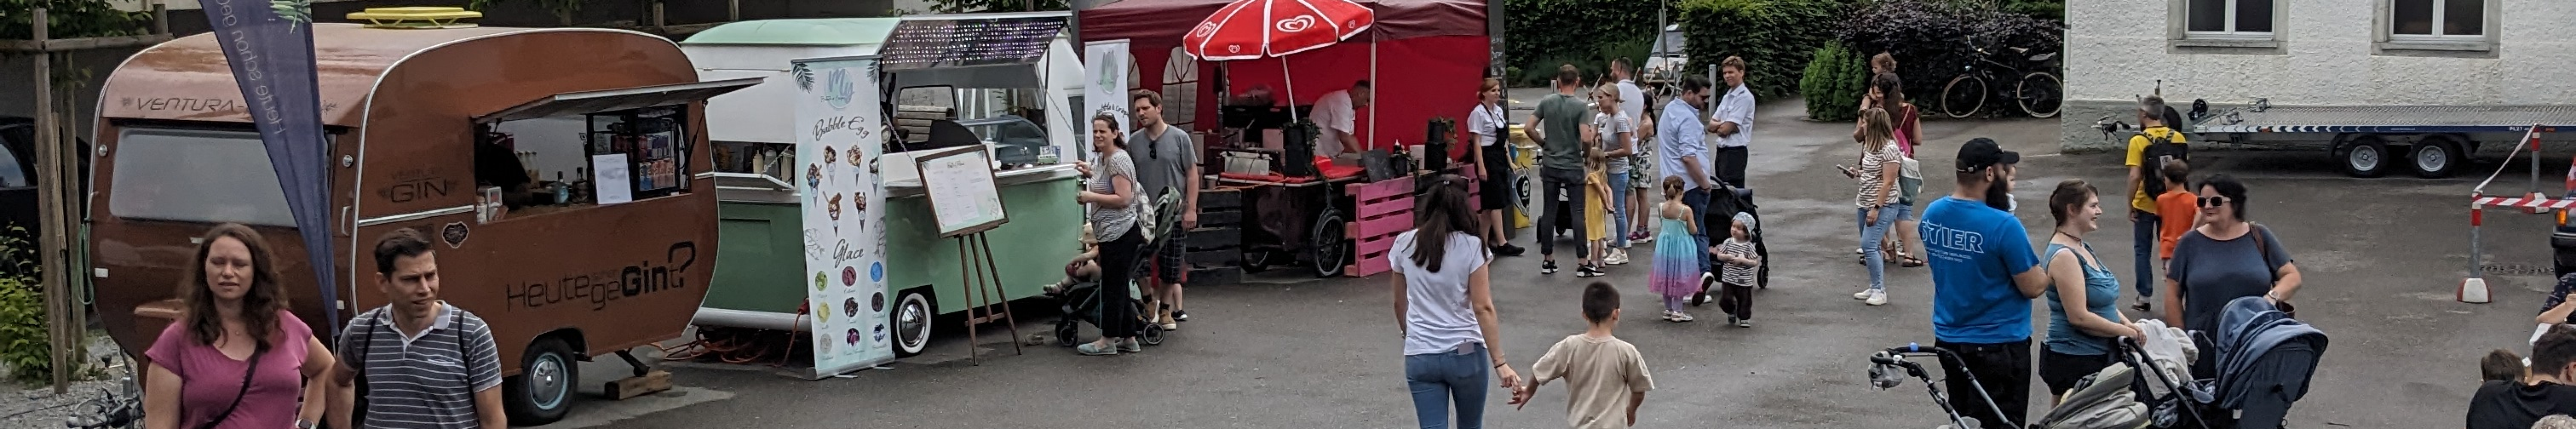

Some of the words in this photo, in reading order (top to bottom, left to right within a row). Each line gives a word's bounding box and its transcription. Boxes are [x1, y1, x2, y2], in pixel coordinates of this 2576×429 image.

[829, 69, 854, 104] My
[812, 115, 845, 141] Bubble
[848, 116, 869, 139] Egg
[391, 179, 447, 202] GIN
[833, 239, 864, 268] Glace
[507, 274, 589, 312] Heute
